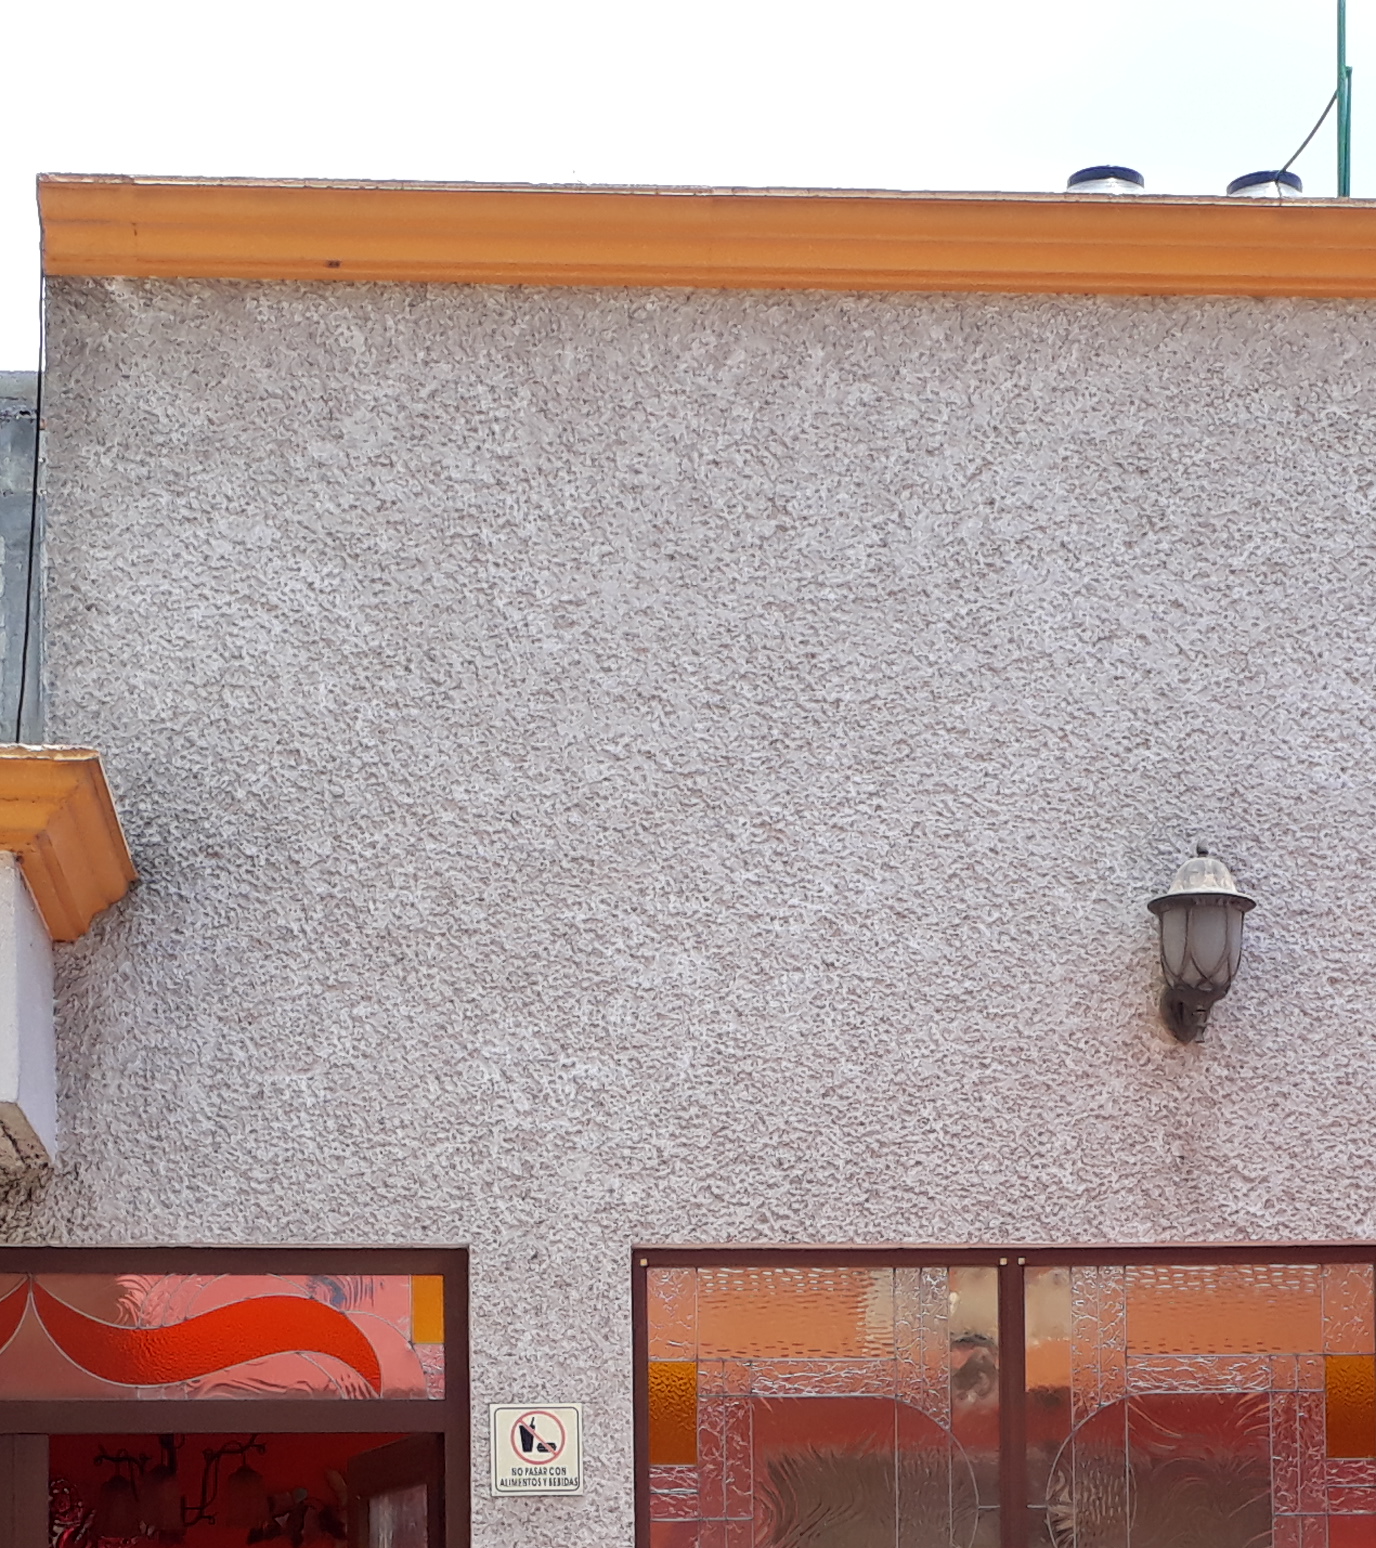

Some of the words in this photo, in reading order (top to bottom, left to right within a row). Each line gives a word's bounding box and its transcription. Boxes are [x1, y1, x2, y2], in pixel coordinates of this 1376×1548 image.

[511, 1467, 523, 1476] NO
[525, 1467, 547, 1476] PASAR
[549, 1467, 567, 1476] CON
[500, 1478, 541, 1487] ALIMENTOS
[543, 1477, 548, 1487] Y
[548, 1477, 578, 1487] BEBIDAS
